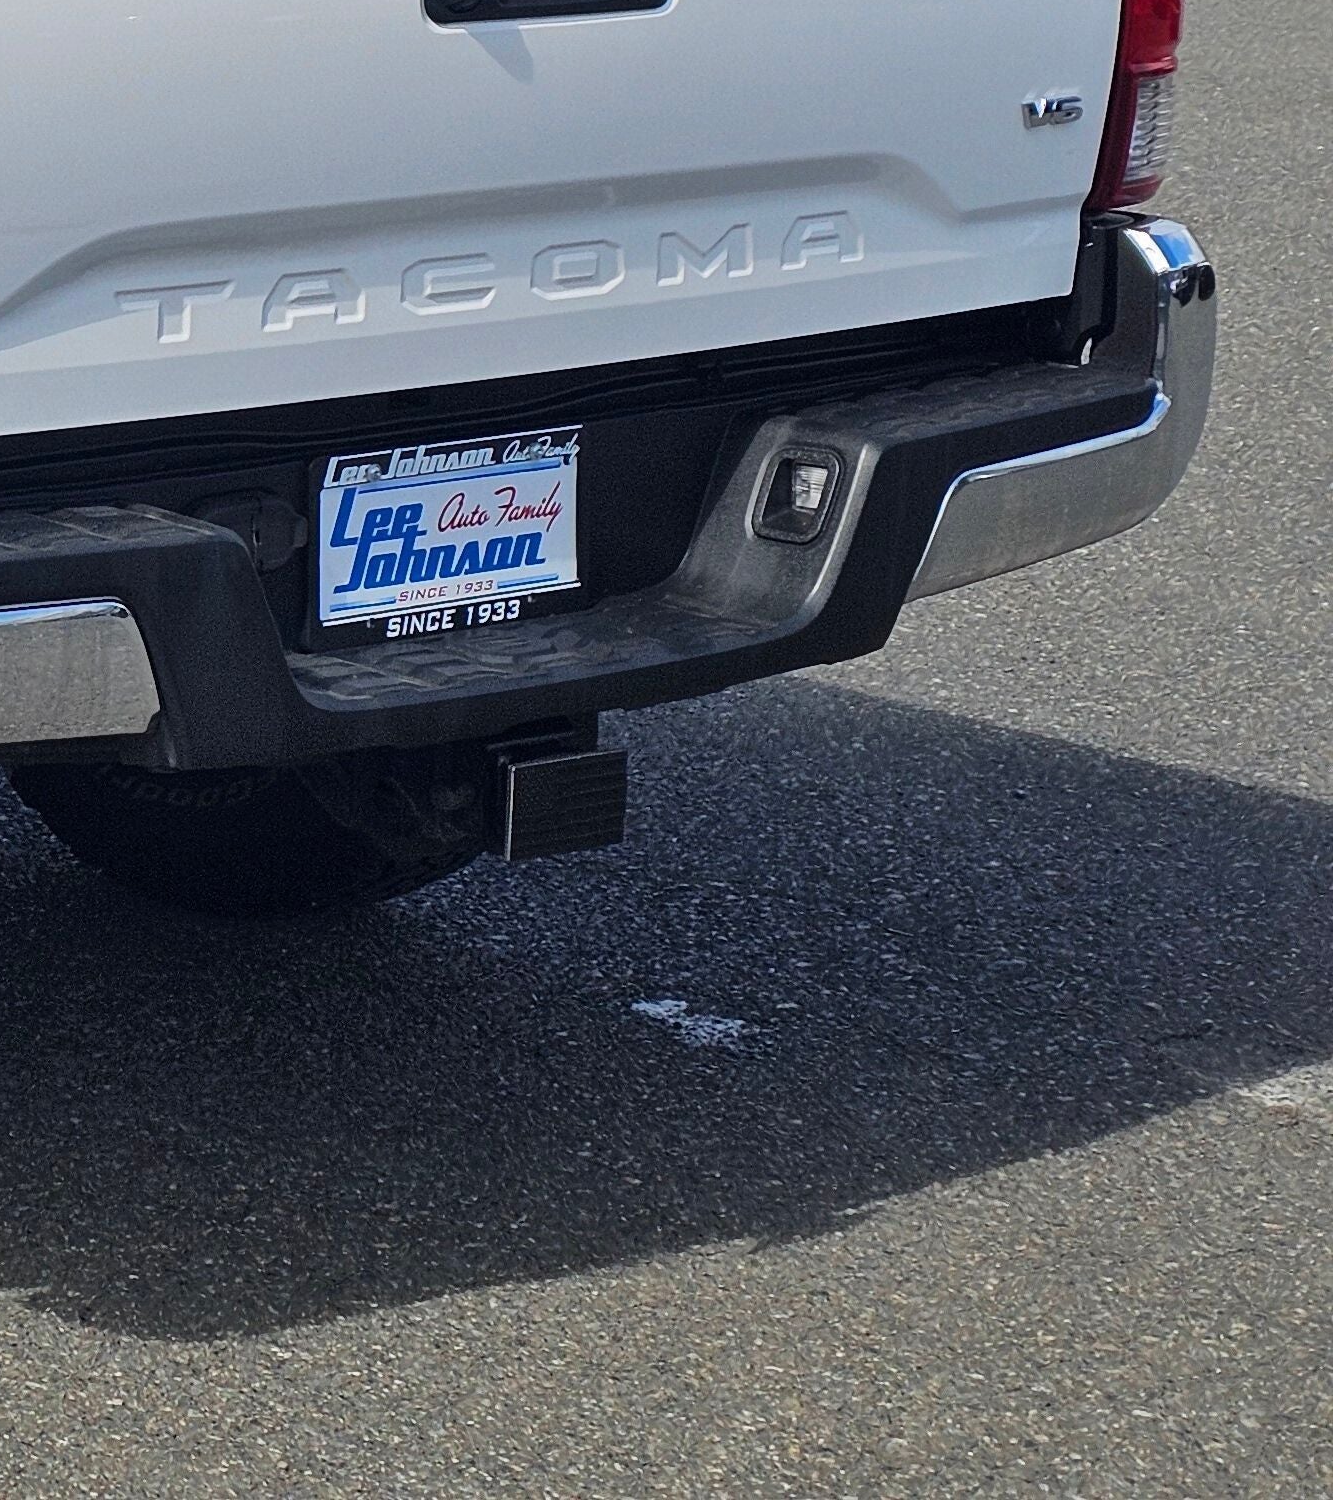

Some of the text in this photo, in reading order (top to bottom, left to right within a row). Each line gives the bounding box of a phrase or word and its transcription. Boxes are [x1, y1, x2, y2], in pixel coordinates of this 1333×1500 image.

[1020, 96, 1084, 130] V6
[114, 209, 866, 345] TACOMA
[380, 445, 496, 481] Johnson
[502, 439, 539, 463] Aut
[330, 481, 564, 548] Lee Auto Family
[333, 530, 547, 594] Johnson
[397, 579, 495, 602] SINCE 1933
[386, 599, 521, 638] SINCE 1933
